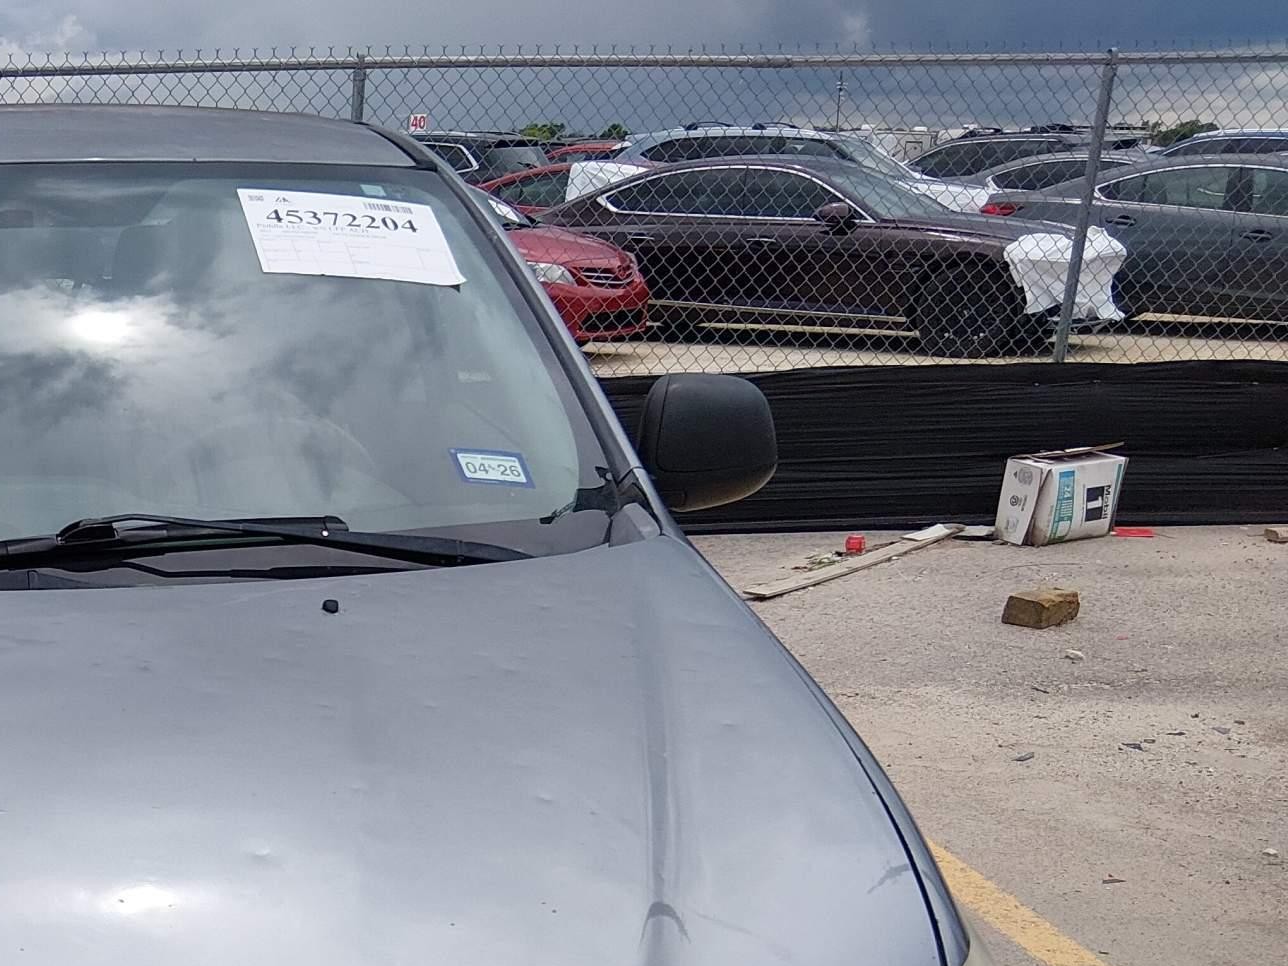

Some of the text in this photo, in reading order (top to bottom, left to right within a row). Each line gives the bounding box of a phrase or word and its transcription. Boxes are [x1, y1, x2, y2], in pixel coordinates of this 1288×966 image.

[411, 115, 426, 130] 40
[266, 209, 418, 232] 45372204
[1102, 485, 1112, 519] Mobil
